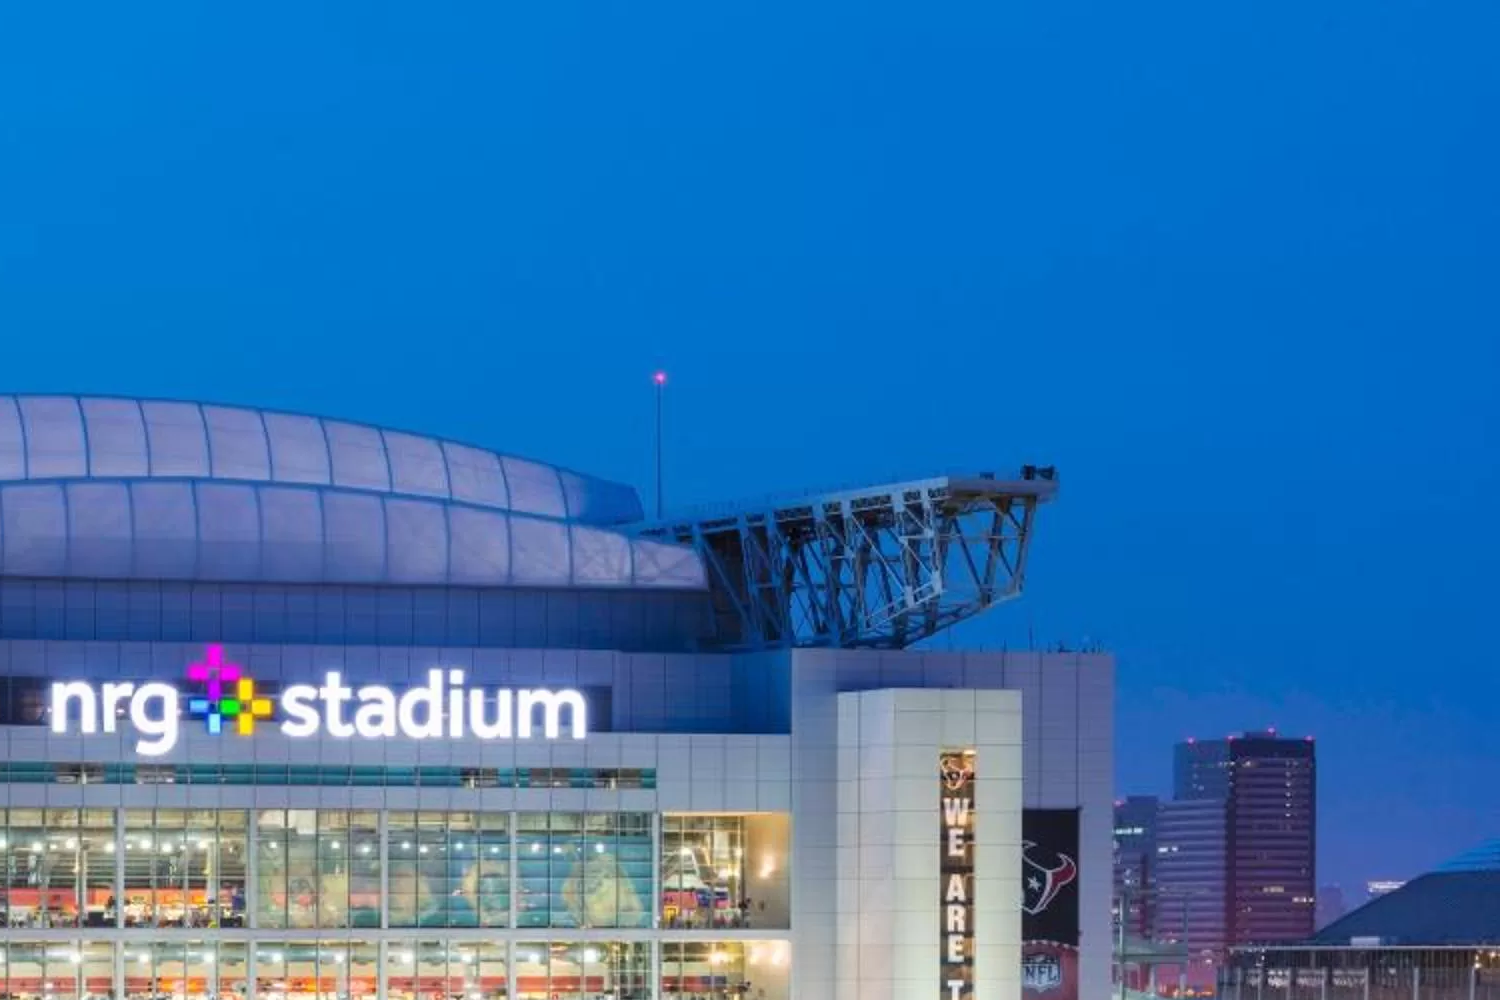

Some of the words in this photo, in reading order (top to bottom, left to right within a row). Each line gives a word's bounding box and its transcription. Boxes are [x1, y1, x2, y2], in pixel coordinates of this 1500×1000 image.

[50, 680, 179, 757] nrg
[280, 668, 588, 740] stadium
[942, 797, 970, 857] WE
[946, 873, 966, 963] ARE
[1024, 965, 1058, 984] NFL
